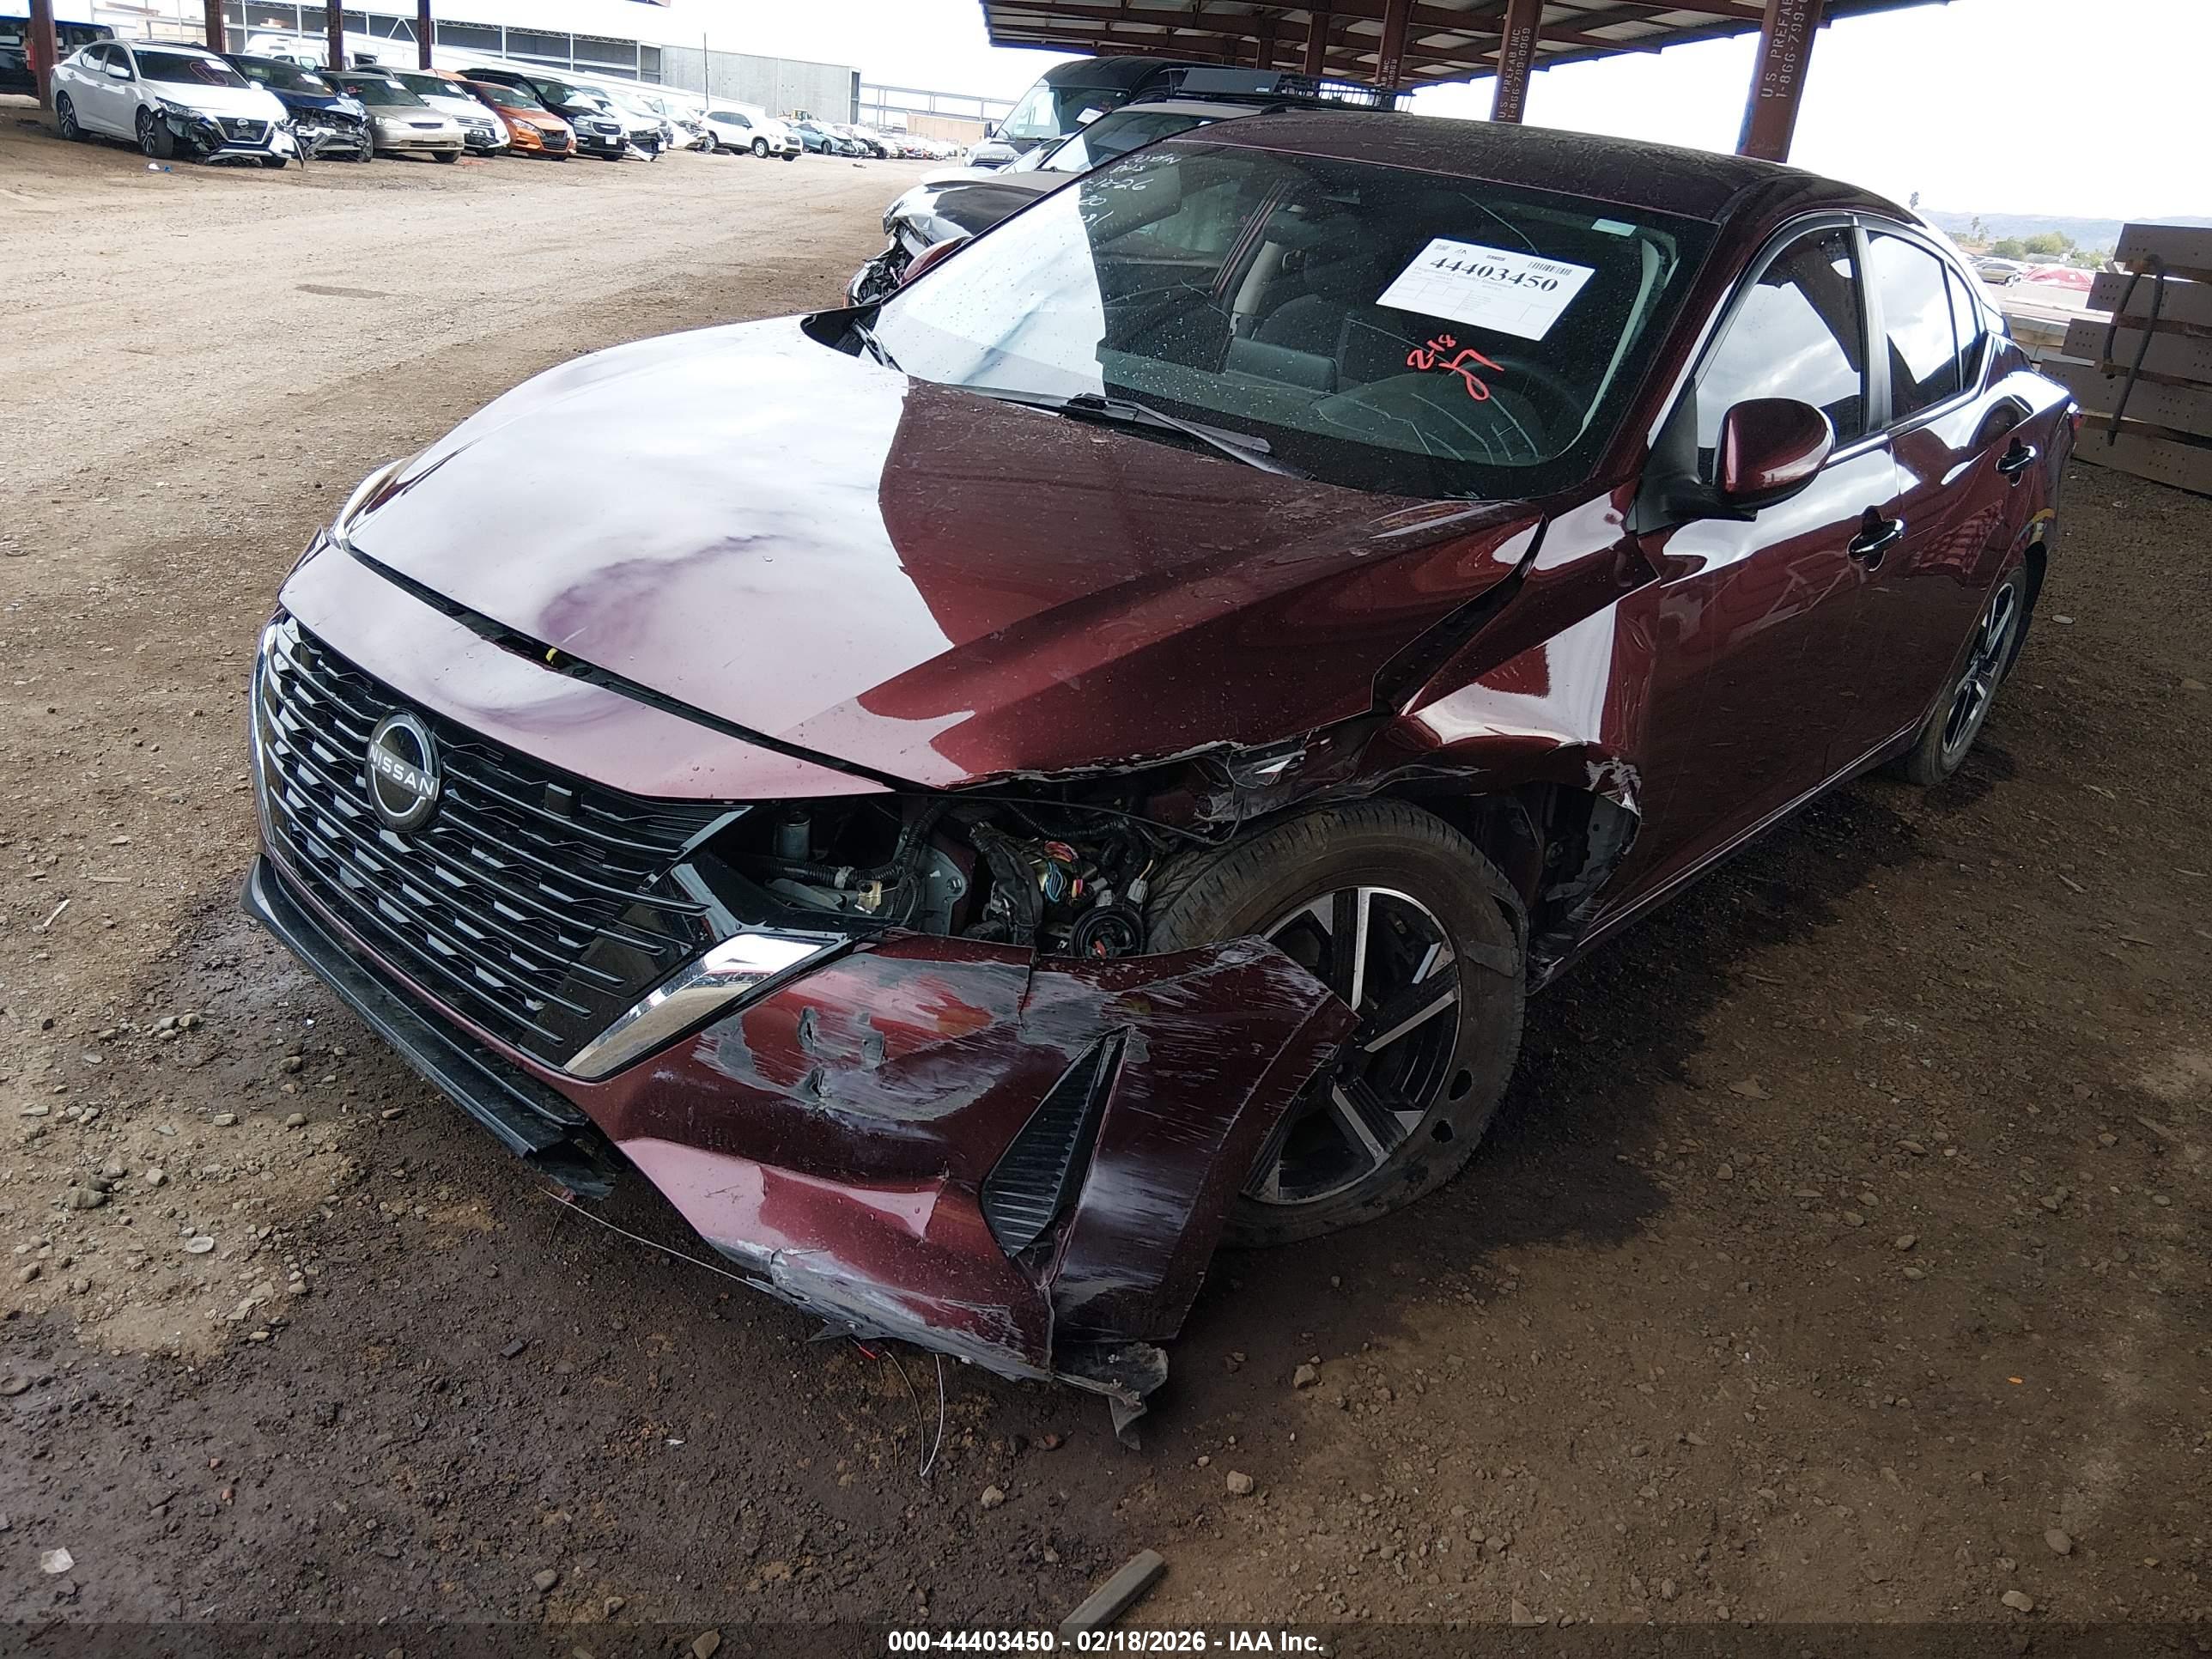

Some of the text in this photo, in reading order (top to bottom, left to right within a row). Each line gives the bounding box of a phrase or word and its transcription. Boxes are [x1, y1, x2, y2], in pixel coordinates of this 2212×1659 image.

[1503, 52, 1517, 93] PREFAB
[1507, 27, 1531, 118] 1-866-799-0969
[1429, 257, 1559, 292] 44403450
[368, 744, 434, 796] NISSAN
